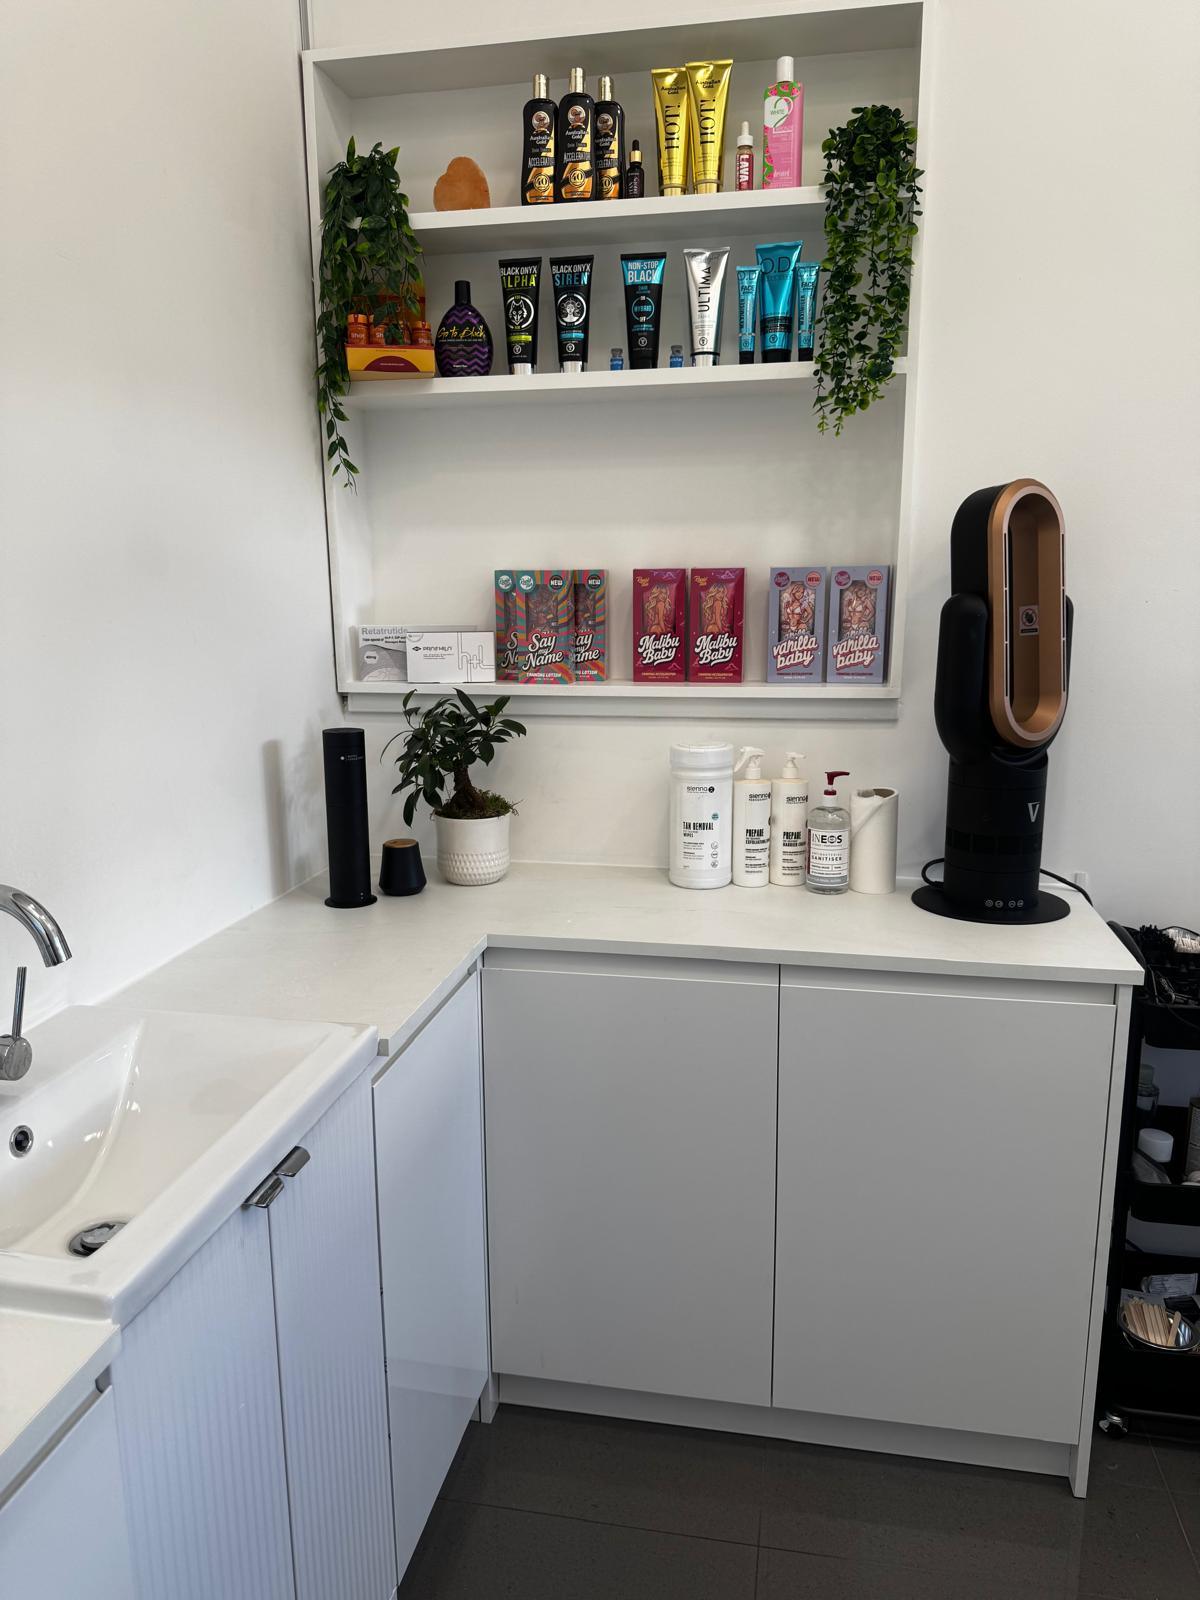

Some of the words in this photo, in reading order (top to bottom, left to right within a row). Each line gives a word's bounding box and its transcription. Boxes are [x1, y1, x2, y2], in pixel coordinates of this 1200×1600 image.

[739, 154, 750, 183] LAVA
[500, 266, 520, 276] BLACK
[520, 265, 538, 275] ONYX
[552, 264, 573, 275] BLACK
[573, 263, 591, 273] ONYX
[628, 261, 659, 271] NON-STOP
[554, 272, 588, 288] SIREN
[628, 269, 659, 283] BLACK
[698, 266, 711, 313] ULTIMA
[449, 326, 459, 338] to
[361, 627, 408, 636] Retatrutide
[528, 633, 556, 653] Say
[575, 633, 593, 651] ay
[638, 633, 680, 653] Malibu
[694, 633, 738, 653] Malibu
[773, 635, 818, 656] vanilla
[832, 635, 879, 656] vanilla
[522, 651, 563, 670] Name
[575, 649, 600, 663] ame
[642, 647, 676, 666] Baby
[699, 647, 734, 666] Baby
[777, 651, 813, 669] baby
[836, 651, 874, 669] baby
[683, 821, 692, 831] TAN
[692, 822, 714, 831] REMOVAL
[745, 828, 764, 837] PREPARE
[782, 831, 802, 840] PREPARE
[812, 833, 843, 844] INEOS
